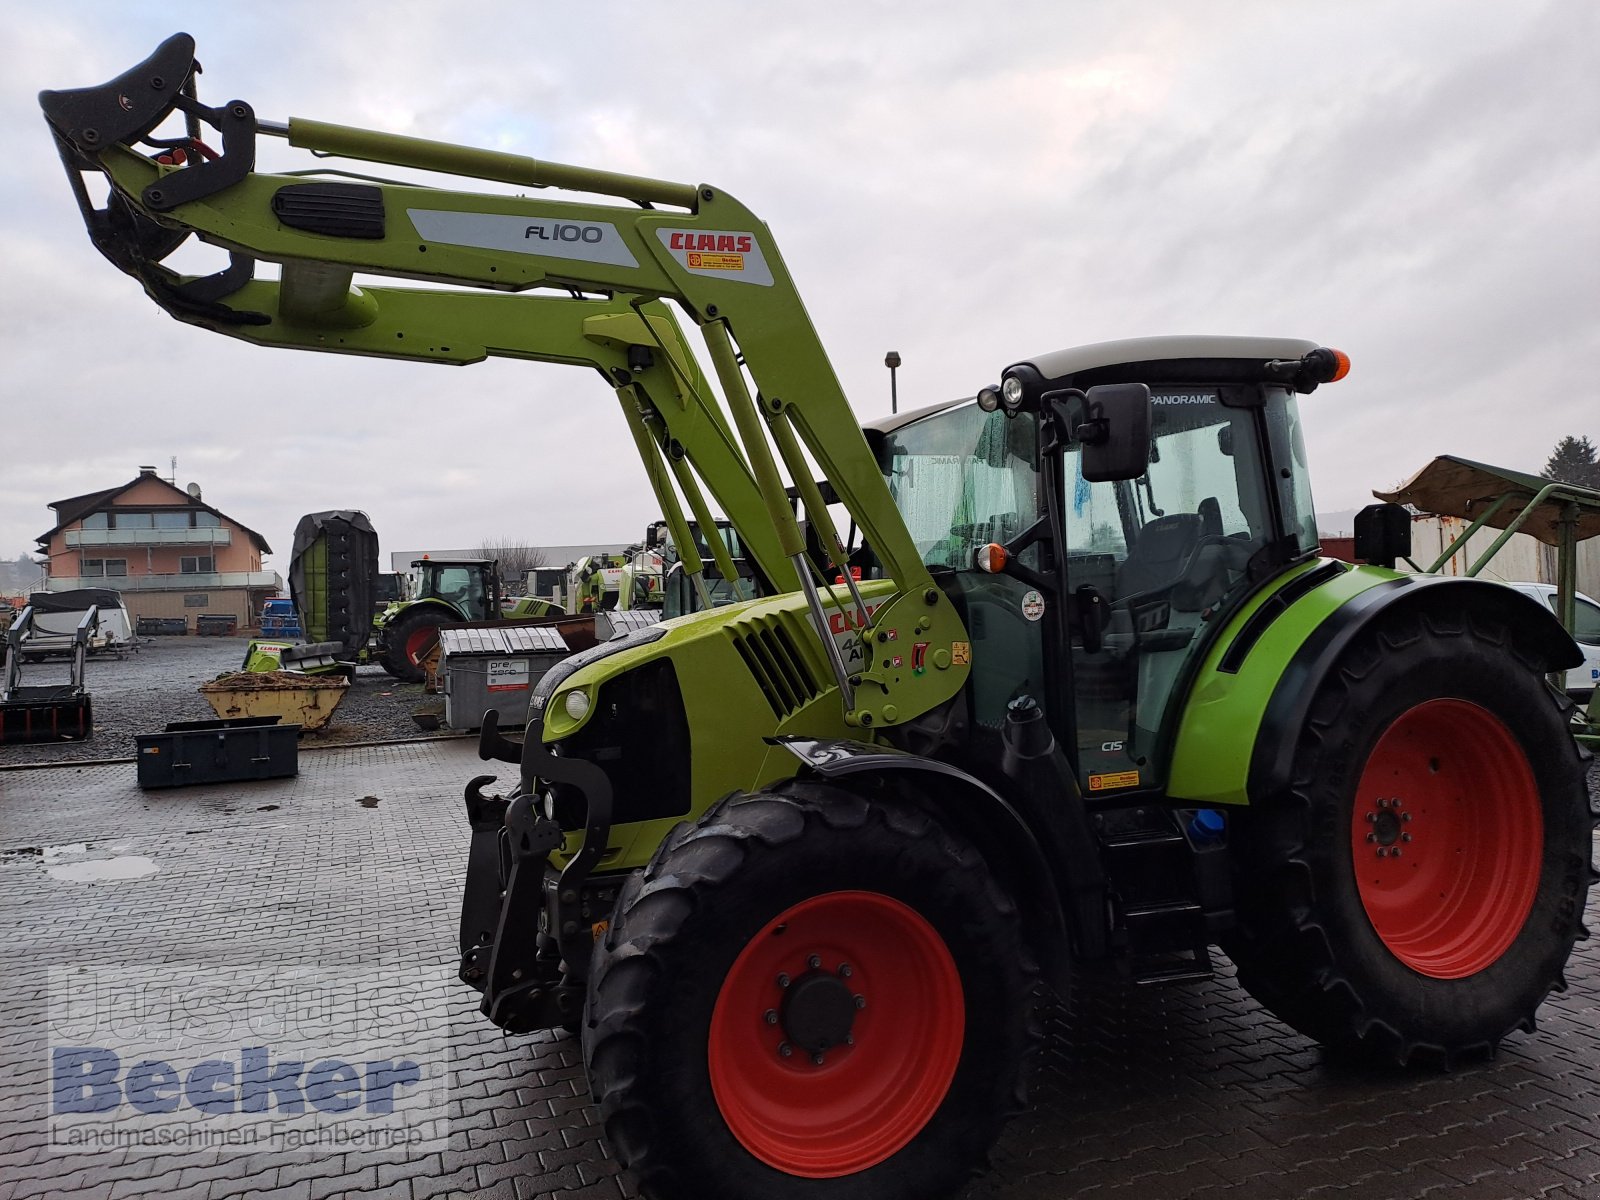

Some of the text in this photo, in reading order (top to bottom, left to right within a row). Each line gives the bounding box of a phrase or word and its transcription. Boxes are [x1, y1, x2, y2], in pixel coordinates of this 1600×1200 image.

[670, 233, 751, 252] CLAAS
[1150, 395, 1215, 405] PANORAMIC
[491, 662, 510, 670] pre
[1101, 741, 1123, 752] CIS
